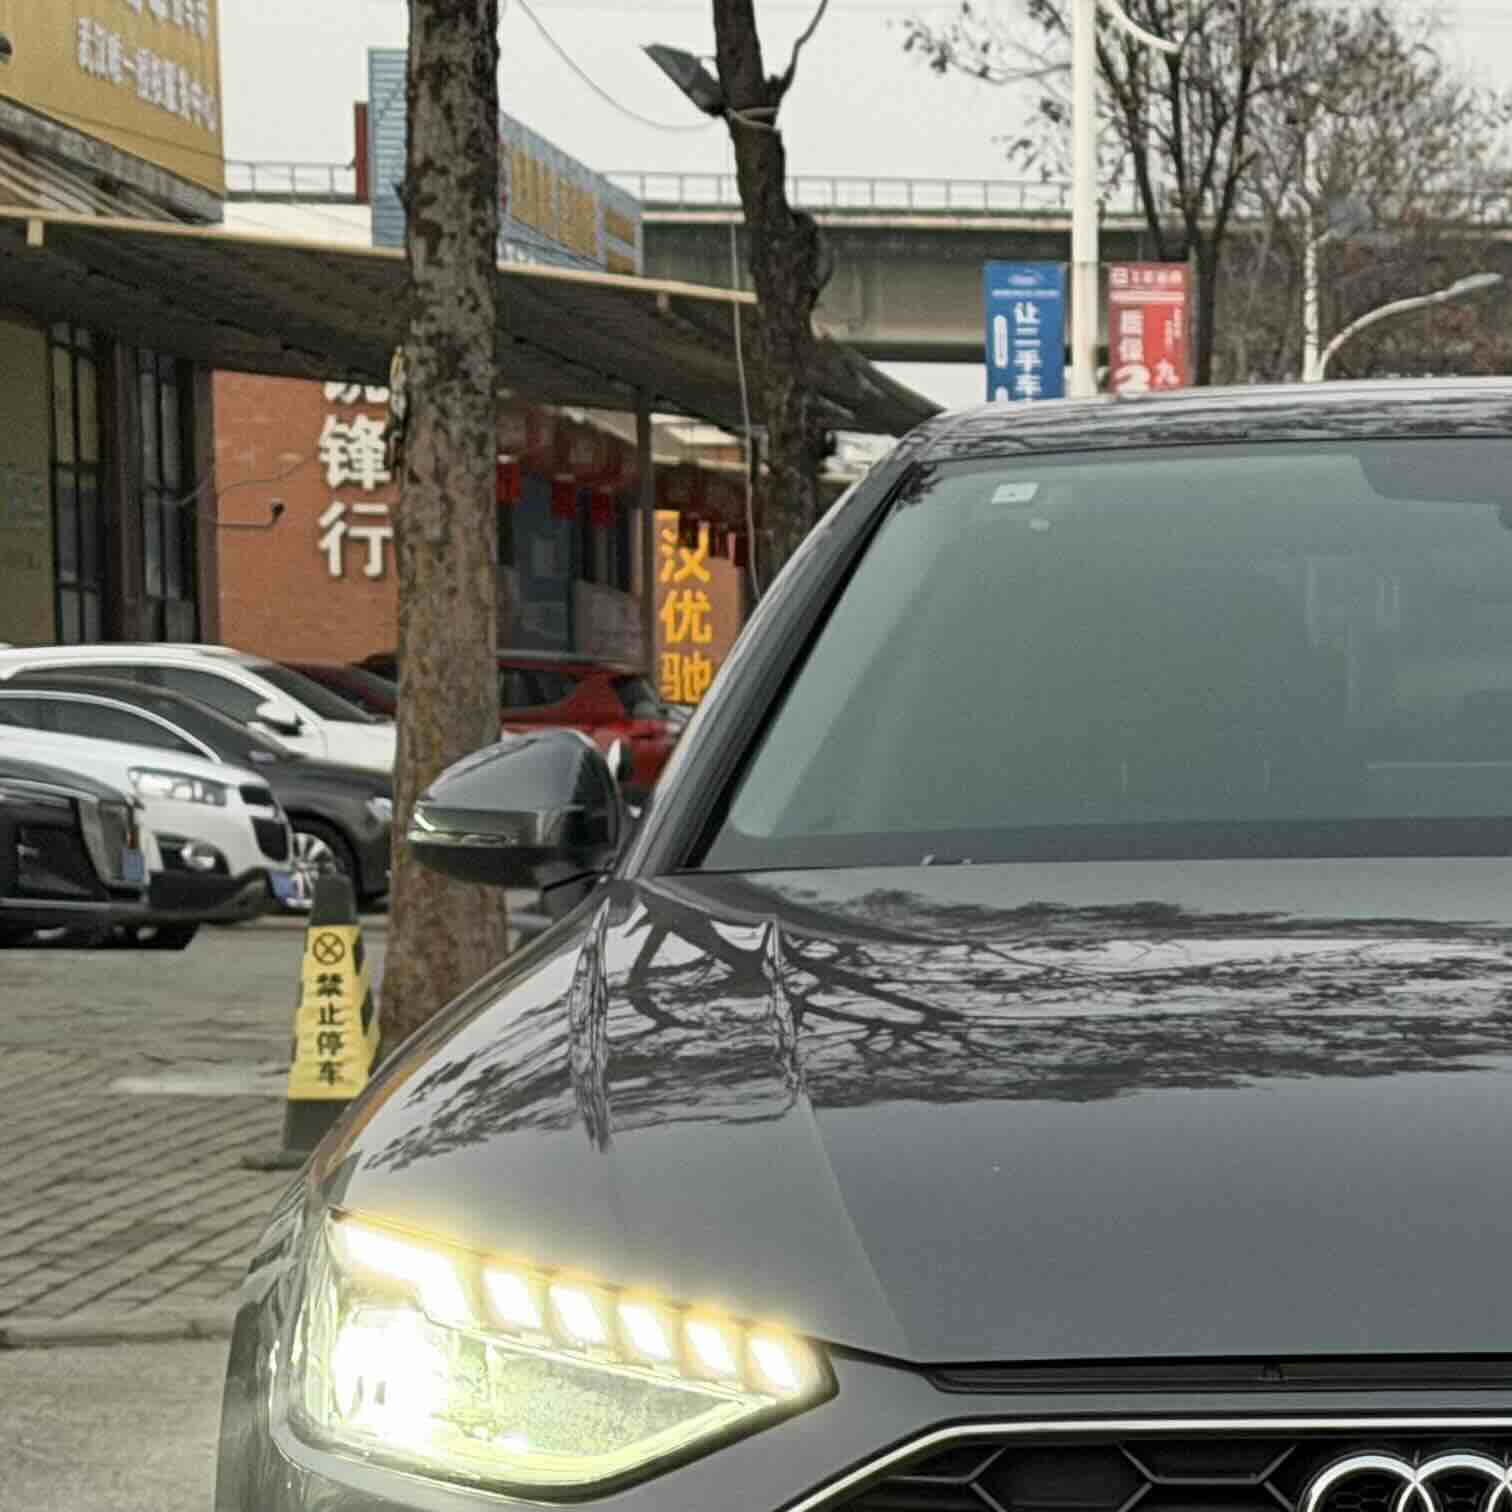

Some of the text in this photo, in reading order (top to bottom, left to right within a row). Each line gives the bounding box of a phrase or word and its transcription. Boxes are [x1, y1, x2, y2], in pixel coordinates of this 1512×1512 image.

[318, 381, 394, 577] 锋行
[316, 972, 345, 1086] 禁止停车
